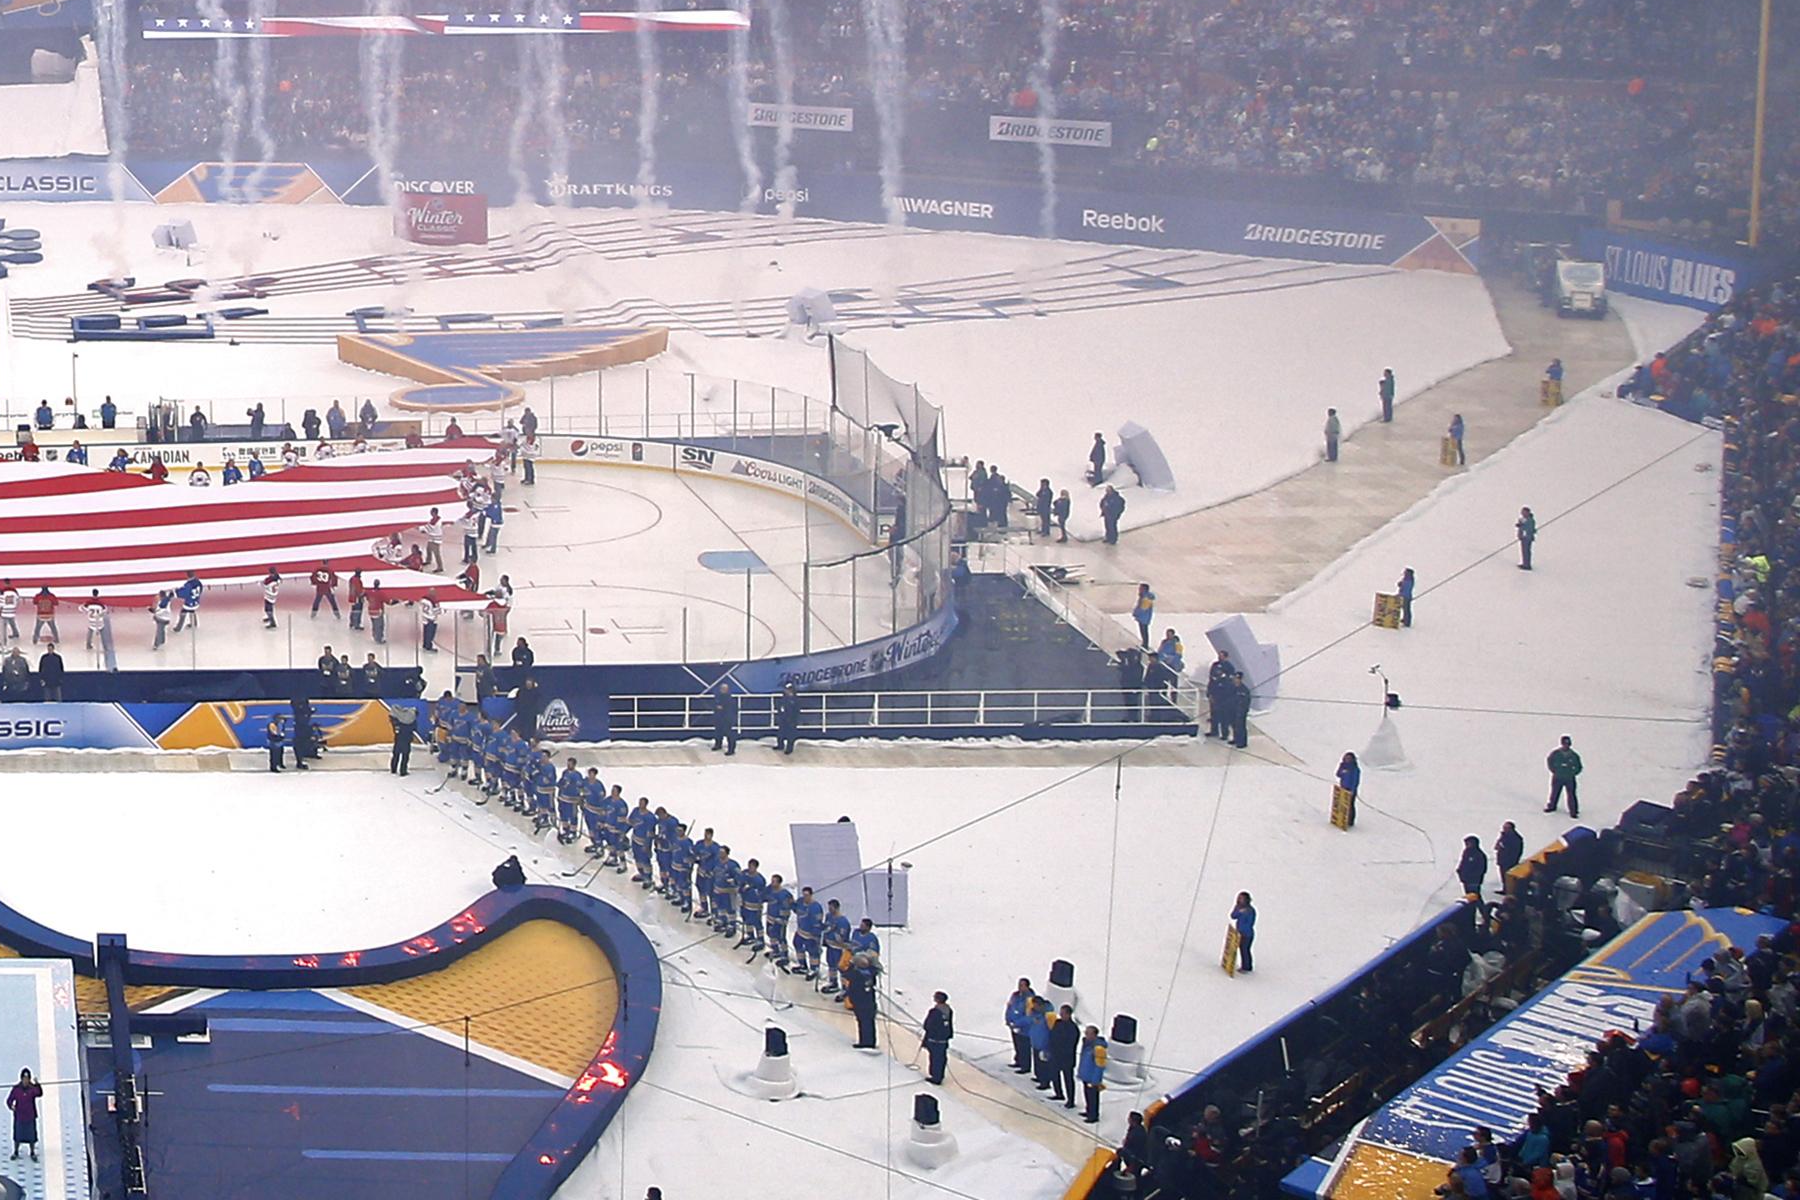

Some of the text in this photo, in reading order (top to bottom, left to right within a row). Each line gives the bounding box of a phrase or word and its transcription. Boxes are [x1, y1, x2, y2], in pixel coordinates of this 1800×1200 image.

[753, 107, 847, 127] BRIGESTONE
[996, 121, 1105, 142] BRIDESTONE
[394, 180, 475, 194] DISCOVER
[550, 182, 673, 197] DRAFTKINGS
[408, 200, 464, 227] Winter
[909, 200, 994, 219] WAGNER
[1082, 208, 1386, 250] Reebok BRIDGESTONE
[1624, 250, 1668, 291] LOUIS
[1669, 257, 1736, 306] BLUES
[134, 450, 190, 465] CANADIAN
[590, 442, 804, 492] pepsi SN Coors LIGHT
[317, 571, 330, 583] 33
[884, 629, 938, 665] Winte
[536, 712, 580, 731] Winter
